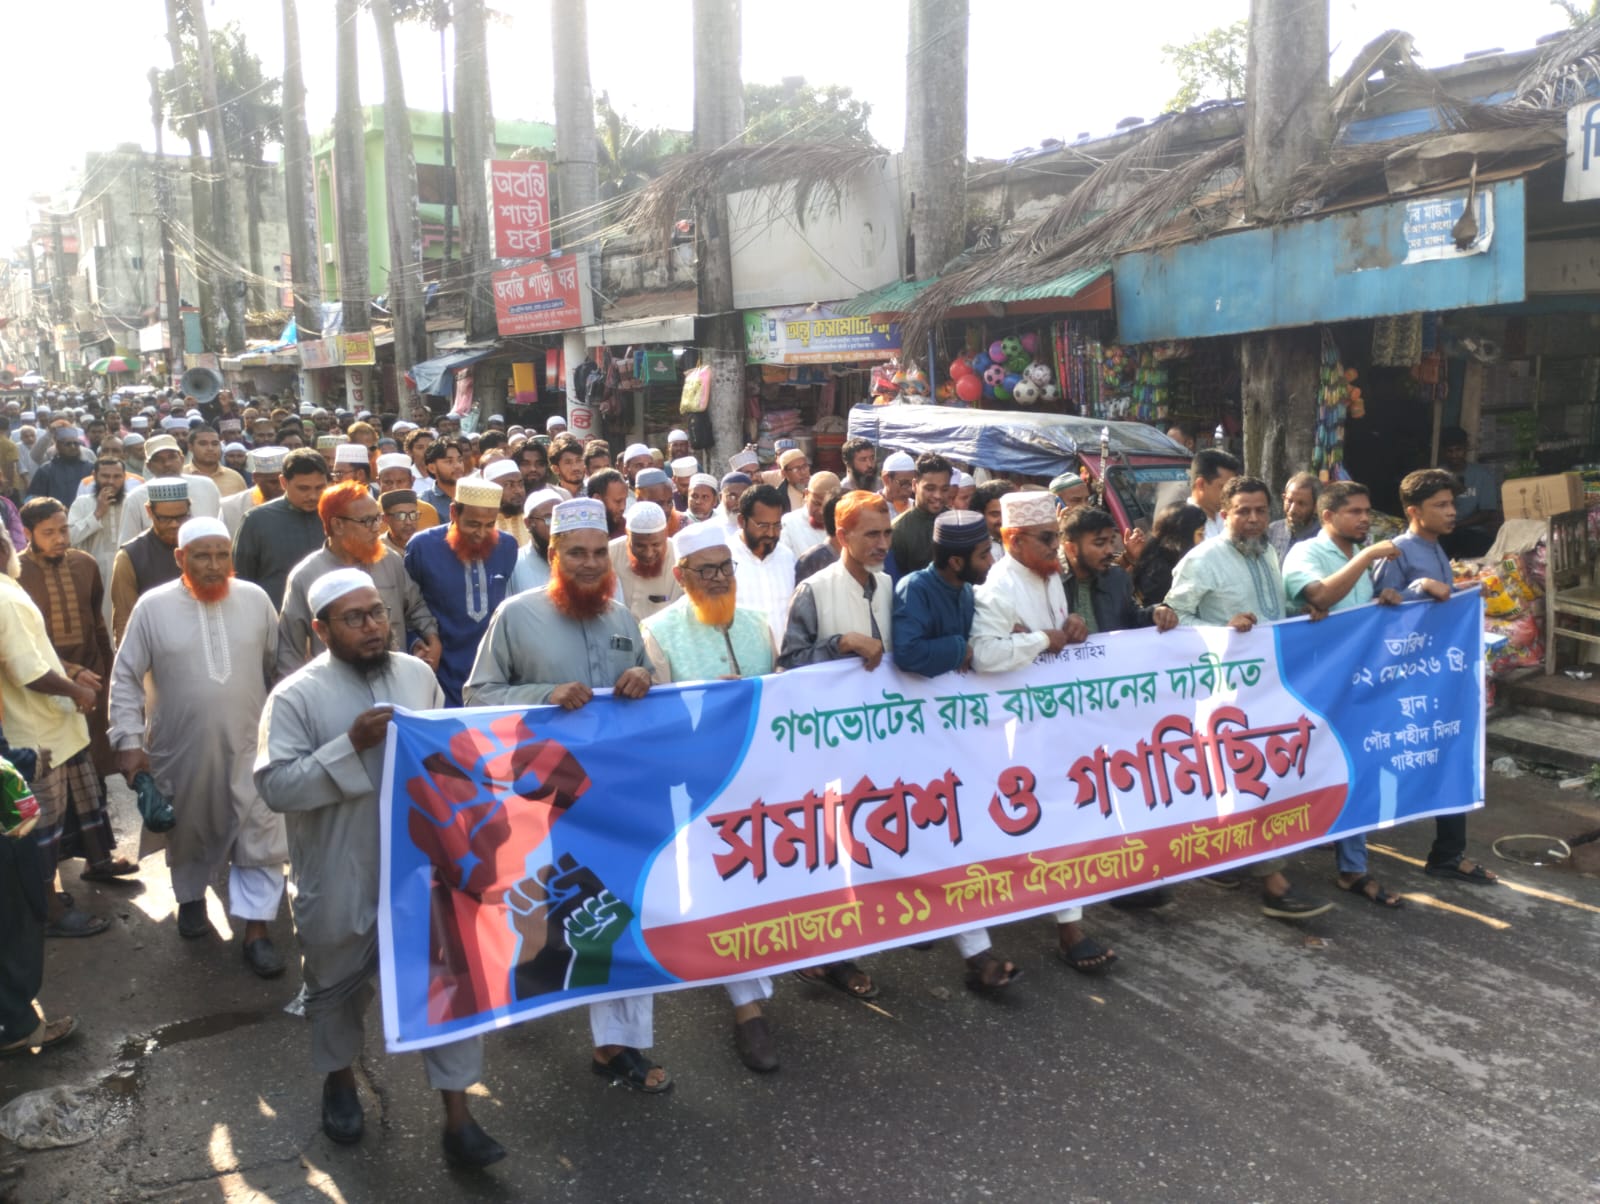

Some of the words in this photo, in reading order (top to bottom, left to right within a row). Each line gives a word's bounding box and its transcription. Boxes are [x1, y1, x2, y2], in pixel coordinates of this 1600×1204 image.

[493, 165, 546, 198] অবন্তি
[499, 199, 544, 227] শাড়ী
[505, 229, 541, 252] ঘর
[1073, 642, 1106, 660] রাহিম
[771, 689, 927, 752] গণভোটের
[934, 692, 990, 730] রায়
[998, 672, 1159, 724] বাস্তবায়নের
[1166, 652, 1265, 699] দাবীতে
[706, 767, 963, 884] সমাবেশ
[988, 765, 1041, 836] ও
[1066, 706, 1317, 818] গণমিছিল
[708, 901, 864, 961] আয়োজনে
[896, 888, 931, 925] ১১
[942, 864, 1015, 912] দলীয়
[1169, 818, 1255, 864] গাইবান্ধা
[1262, 802, 1311, 841] জেলা
